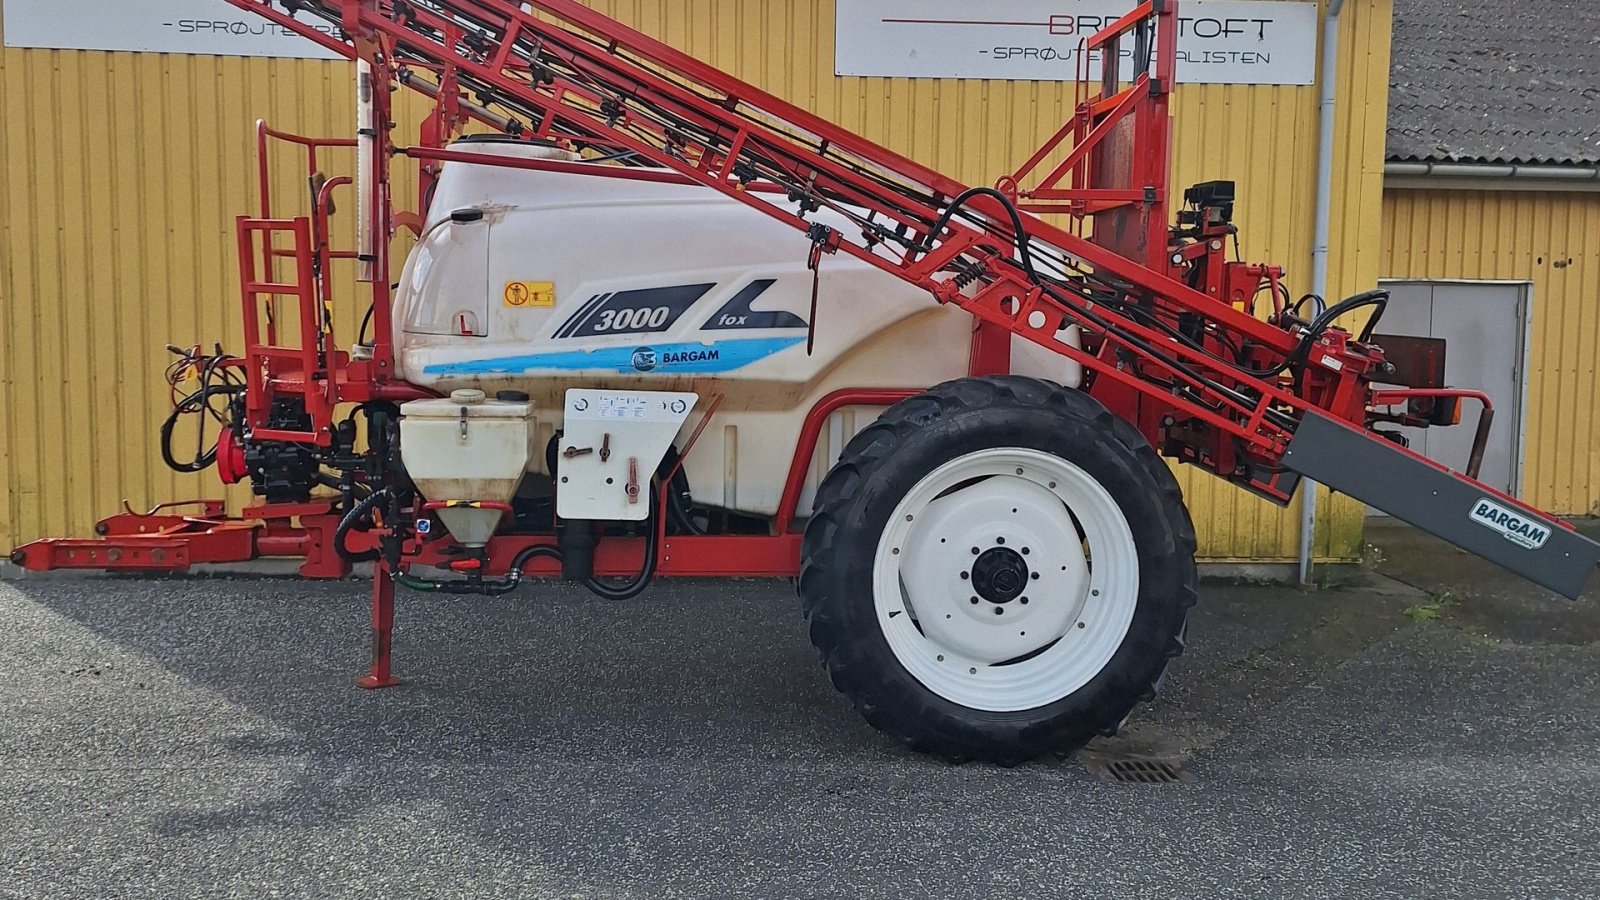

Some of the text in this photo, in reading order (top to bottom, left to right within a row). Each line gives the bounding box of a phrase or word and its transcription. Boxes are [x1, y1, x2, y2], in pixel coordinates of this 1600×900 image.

[594, 306, 670, 331] 3000
[718, 313, 747, 326] fox
[663, 350, 719, 363] BARGAM
[1475, 503, 1545, 543] BARGAM
